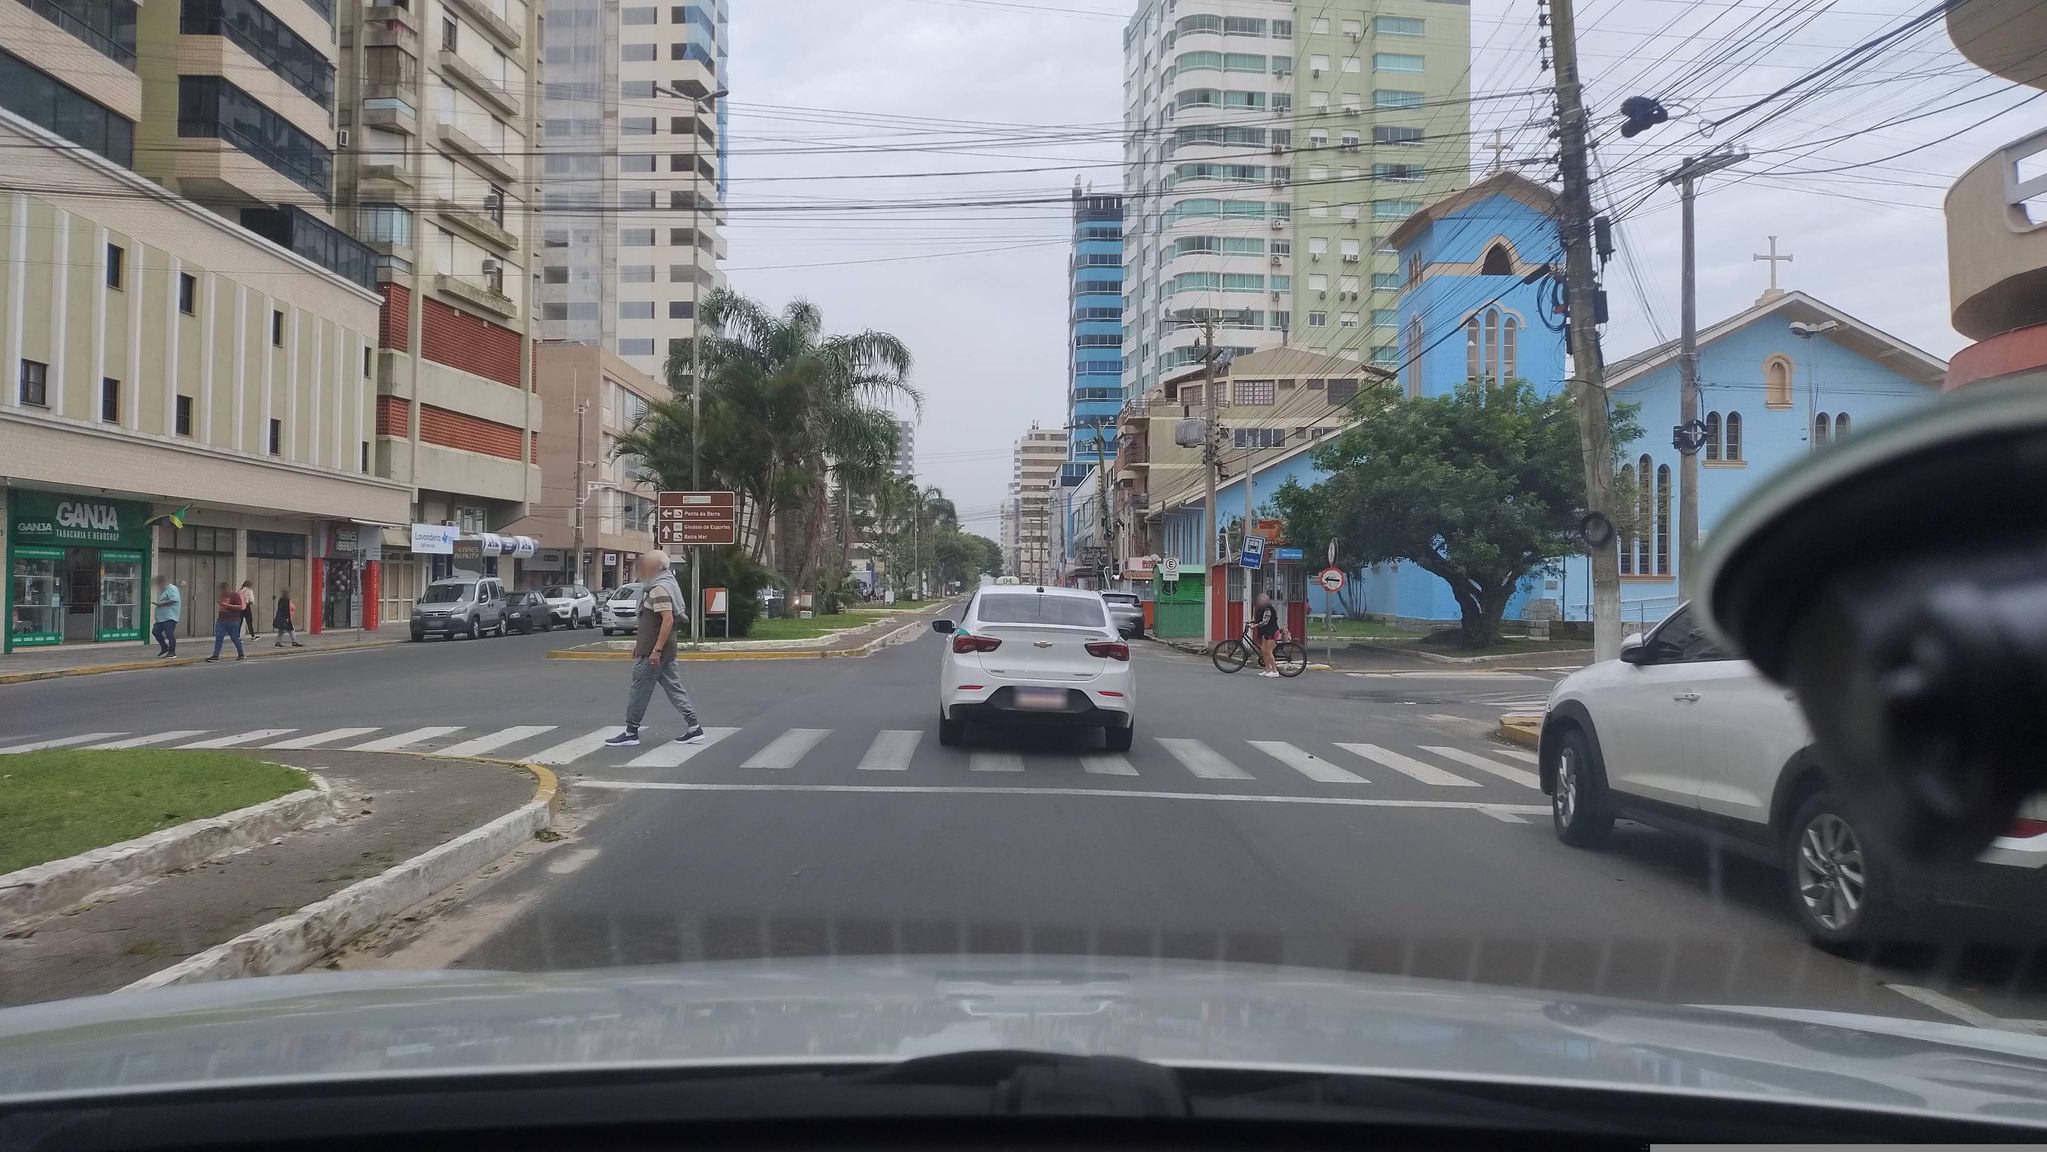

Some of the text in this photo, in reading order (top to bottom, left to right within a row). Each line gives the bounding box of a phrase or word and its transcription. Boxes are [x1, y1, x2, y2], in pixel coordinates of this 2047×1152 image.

[56, 502, 119, 531] GANJA
[17, 522, 53, 532] GANJA
[56, 529, 87, 540] TABACARIA
[93, 532, 120, 541] HEADSHOP
